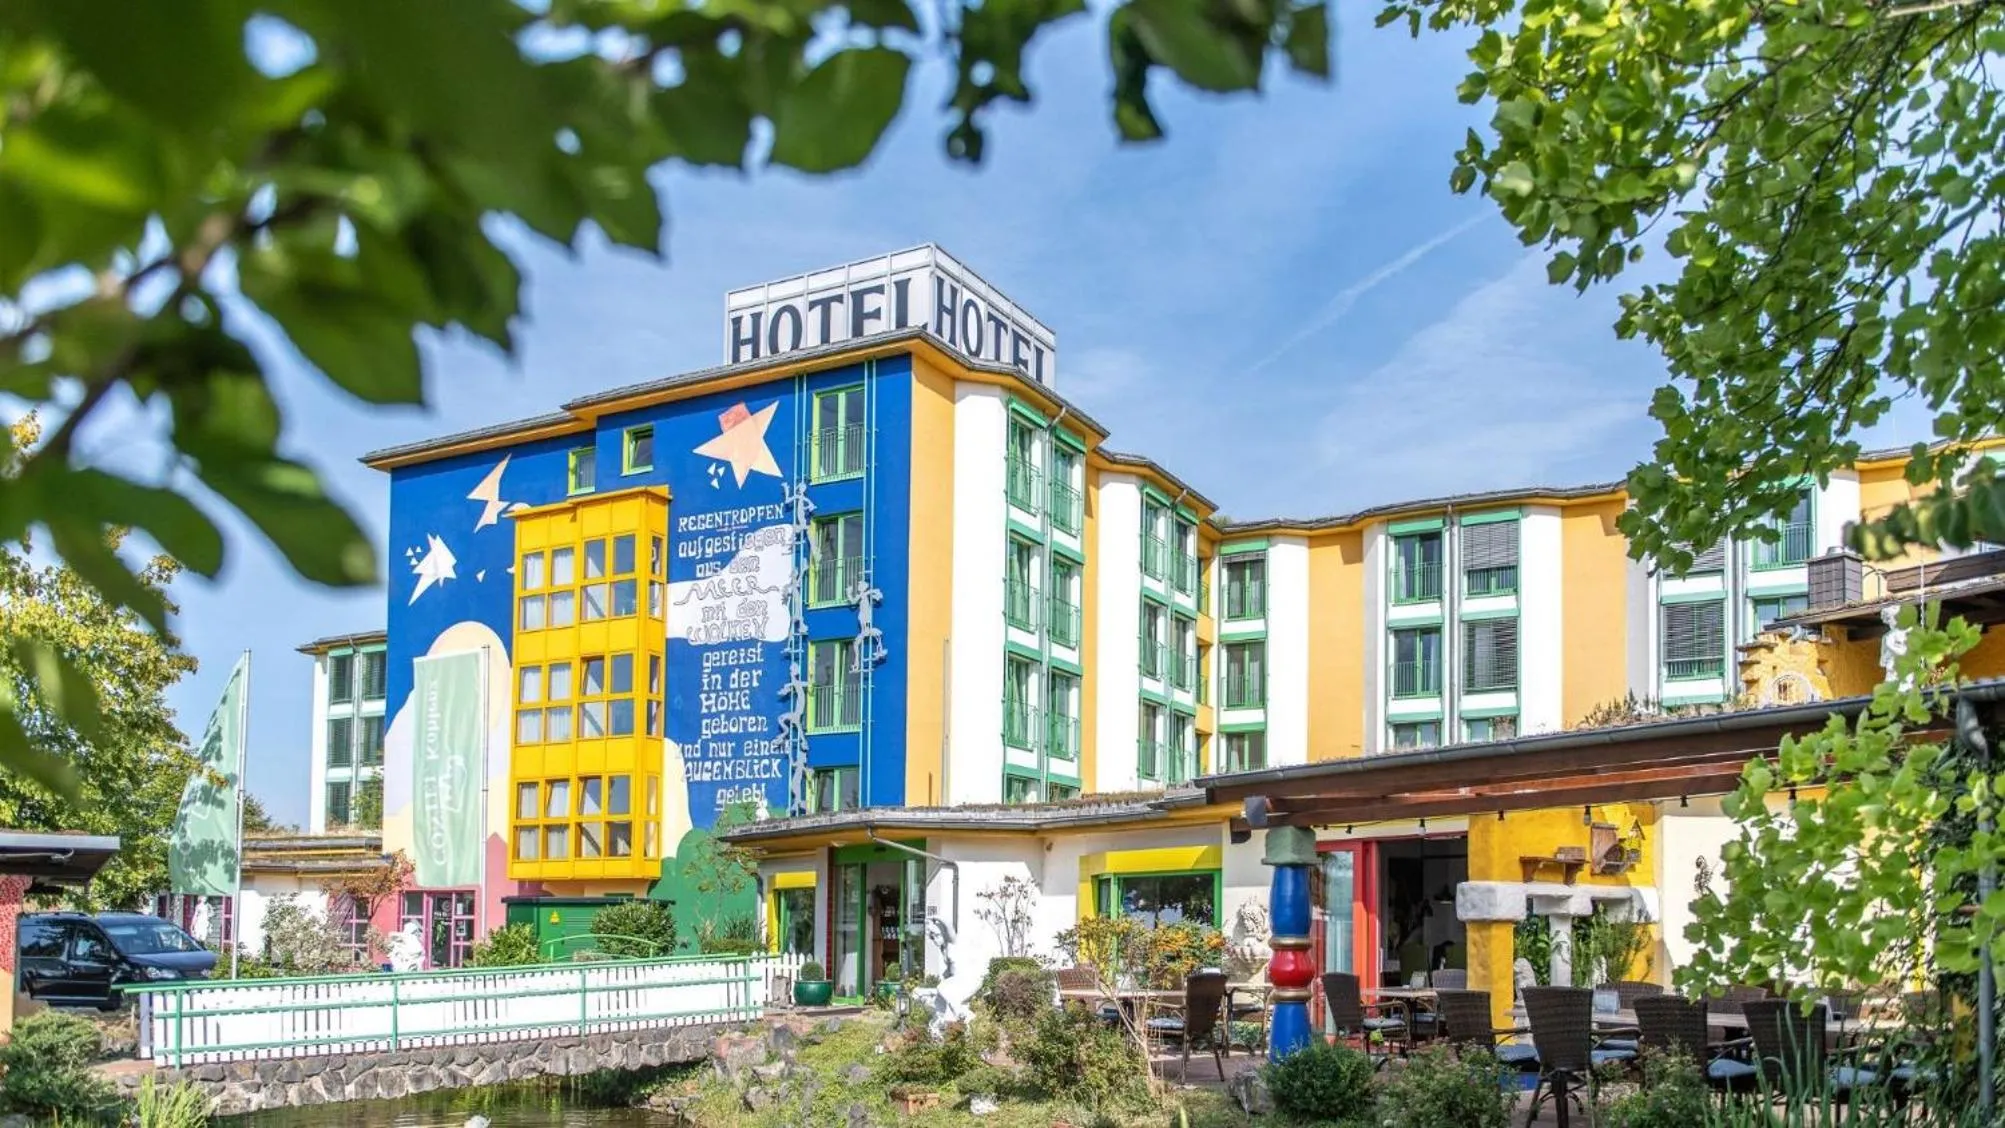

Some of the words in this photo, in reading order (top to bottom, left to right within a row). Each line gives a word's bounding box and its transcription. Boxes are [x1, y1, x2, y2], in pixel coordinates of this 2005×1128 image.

[731, 278, 928, 364] HOTEL
[677, 502, 785, 533] REGENTROPFEN
[678, 527, 785, 559] aufgestiegen
[695, 561, 721, 578] aus
[702, 601, 727, 622] mit
[702, 643, 764, 672] gereist
[702, 673, 722, 690] in
[729, 668, 762, 688] der
[701, 714, 768, 739] geboren
[708, 741, 736, 758] nur
